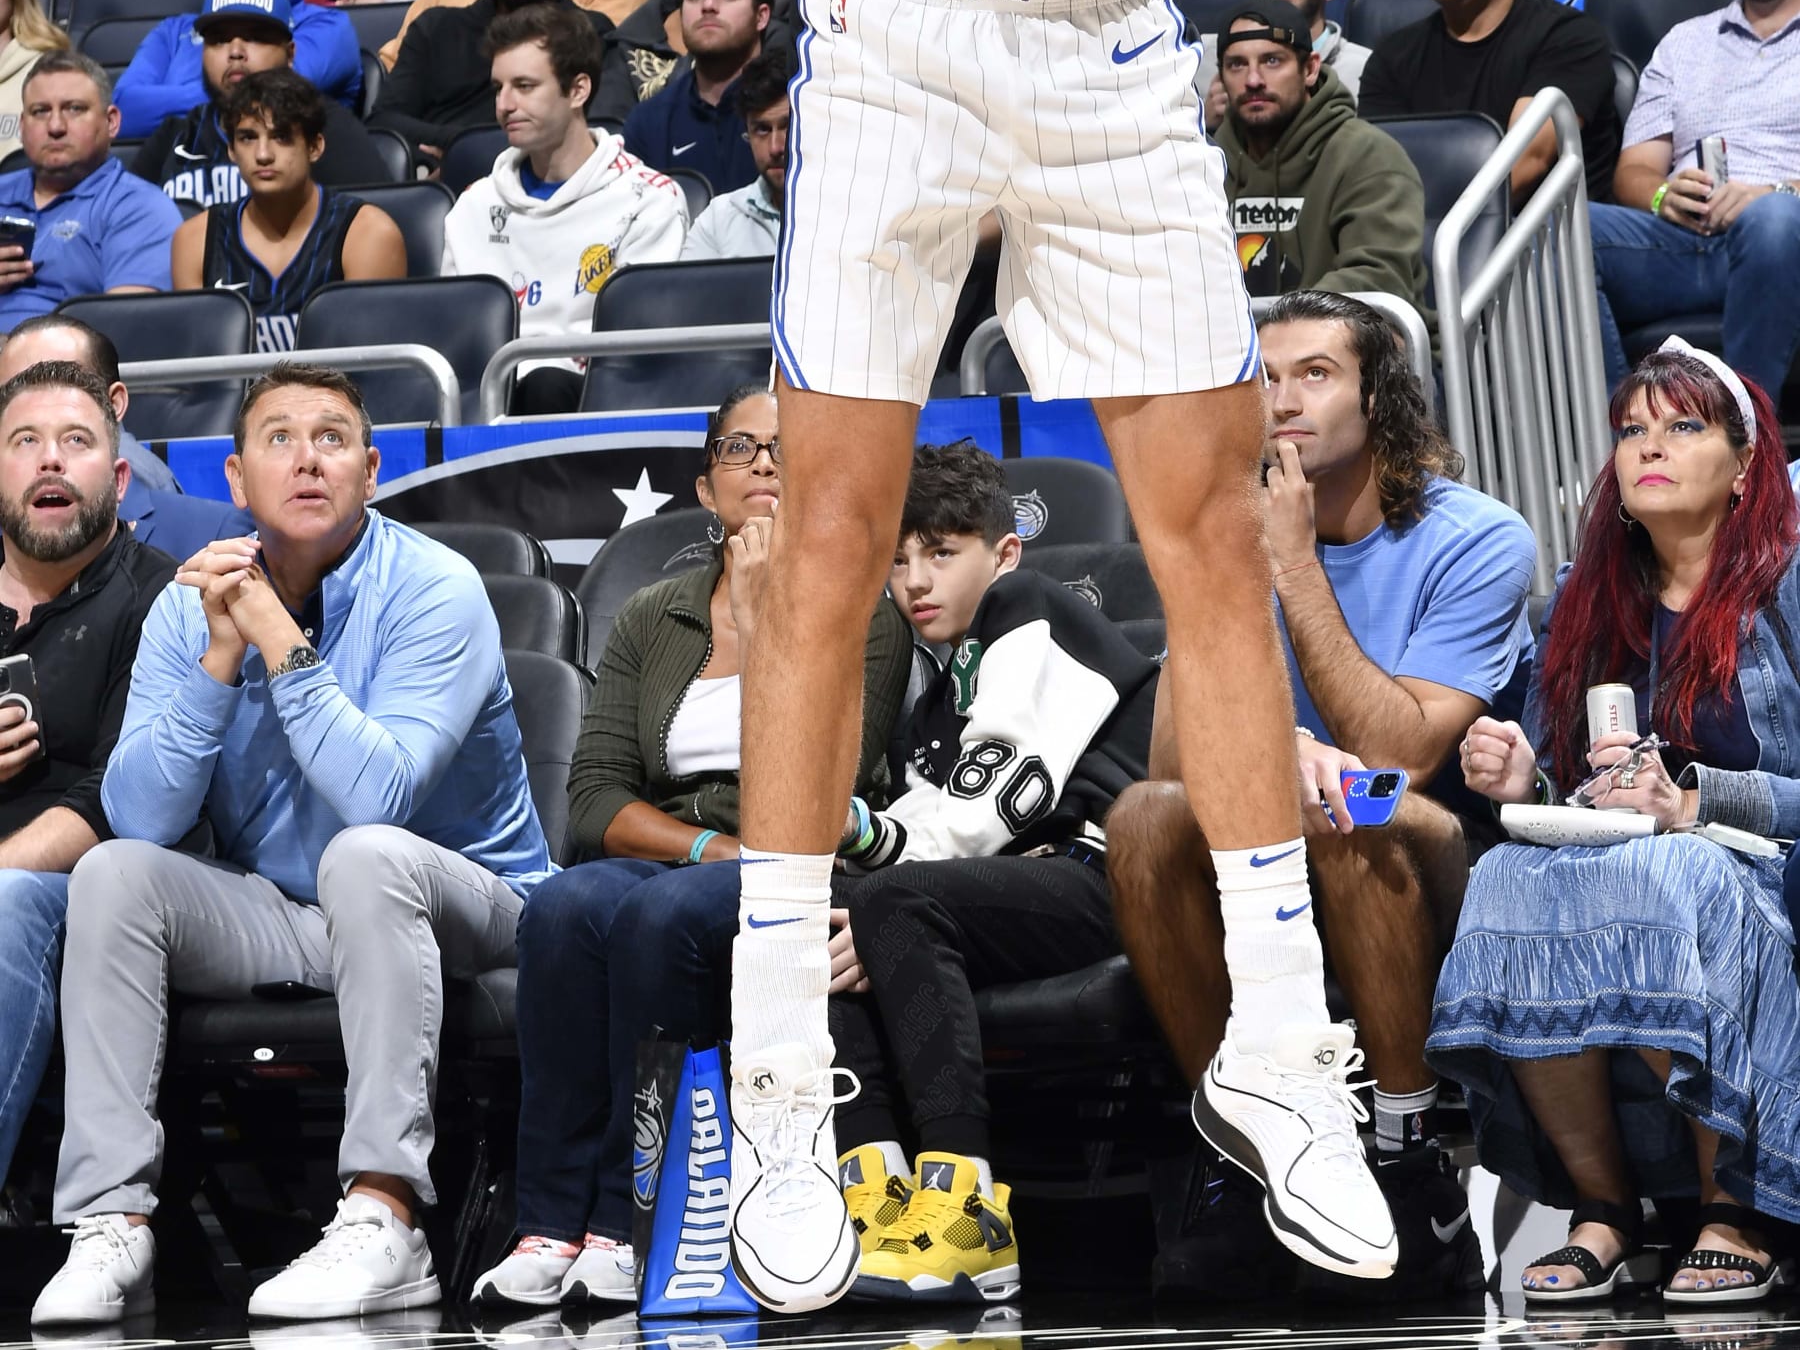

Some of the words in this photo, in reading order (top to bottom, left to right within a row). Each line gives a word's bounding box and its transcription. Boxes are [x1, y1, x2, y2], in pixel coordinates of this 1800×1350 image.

[162, 165, 249, 206] ORLAN
[573, 247, 620, 298] LAKER
[947, 739, 1056, 836] 80
[664, 1087, 731, 1299] ORLANDO
